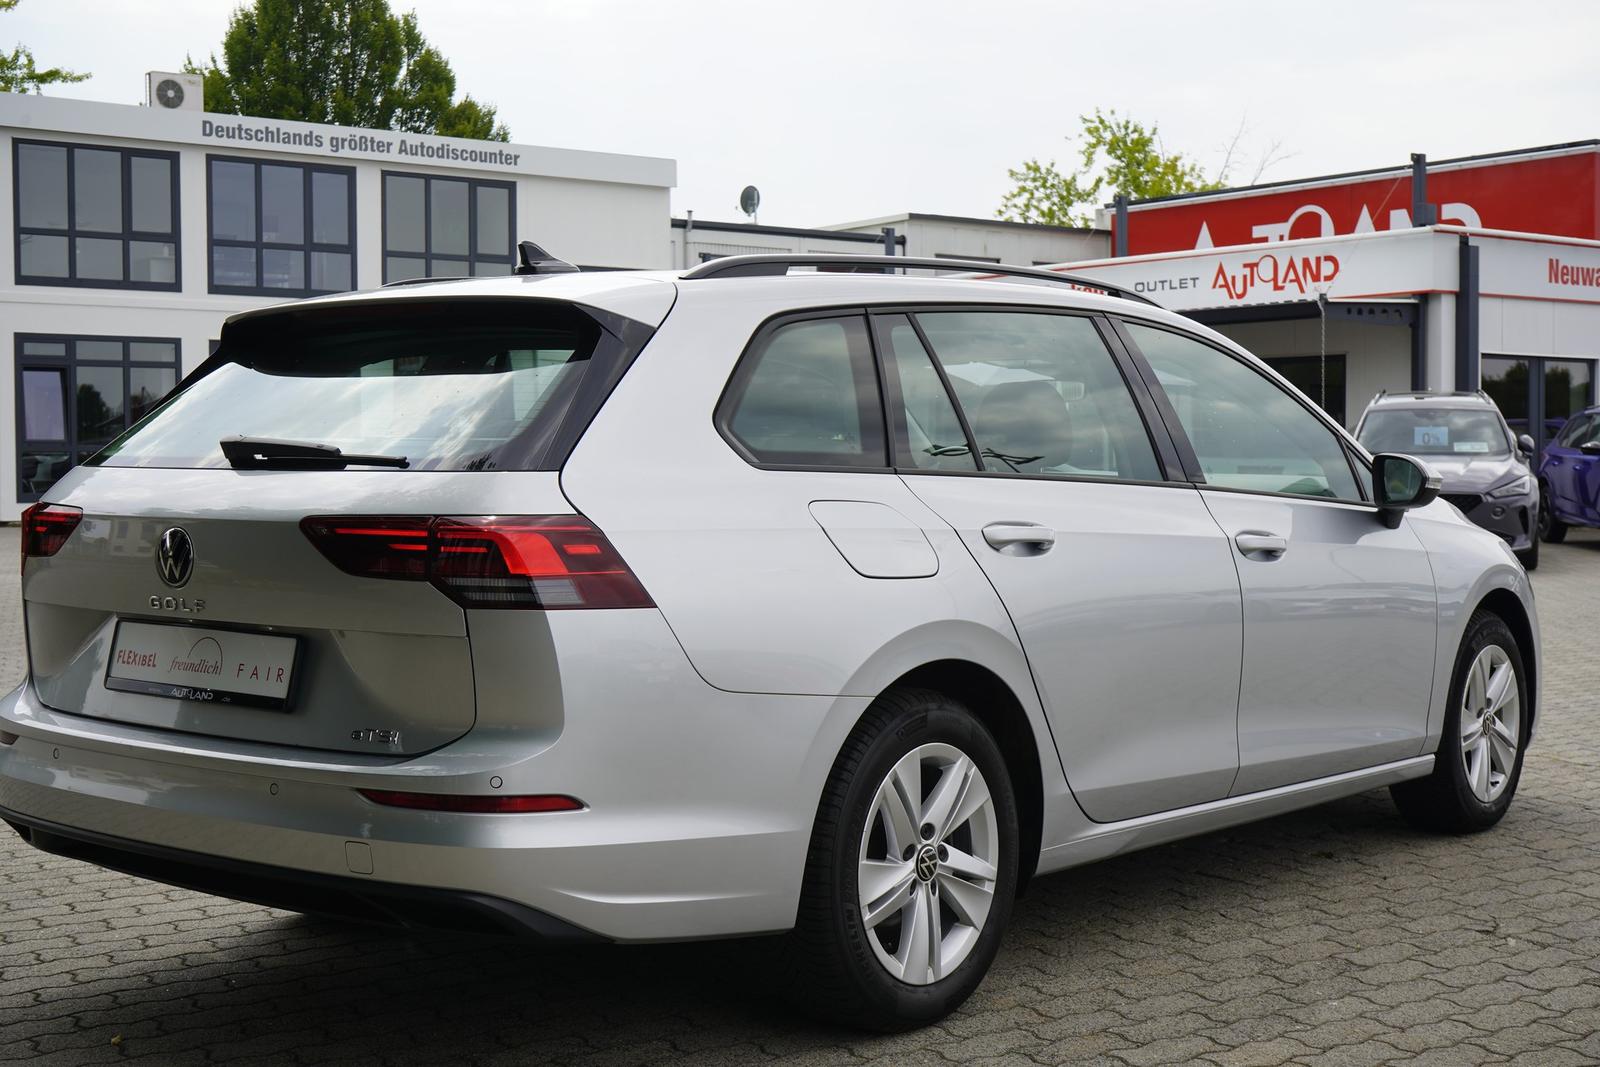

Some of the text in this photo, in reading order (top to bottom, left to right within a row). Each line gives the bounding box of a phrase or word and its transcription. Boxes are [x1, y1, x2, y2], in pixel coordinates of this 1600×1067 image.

[202, 120, 520, 166] Deutschlands größter Autodiscounter
[1134, 277, 1200, 293] OUTLET
[149, 595, 206, 612] GOLF
[117, 650, 285, 683] FLEXIBEL freundlich FAIR
